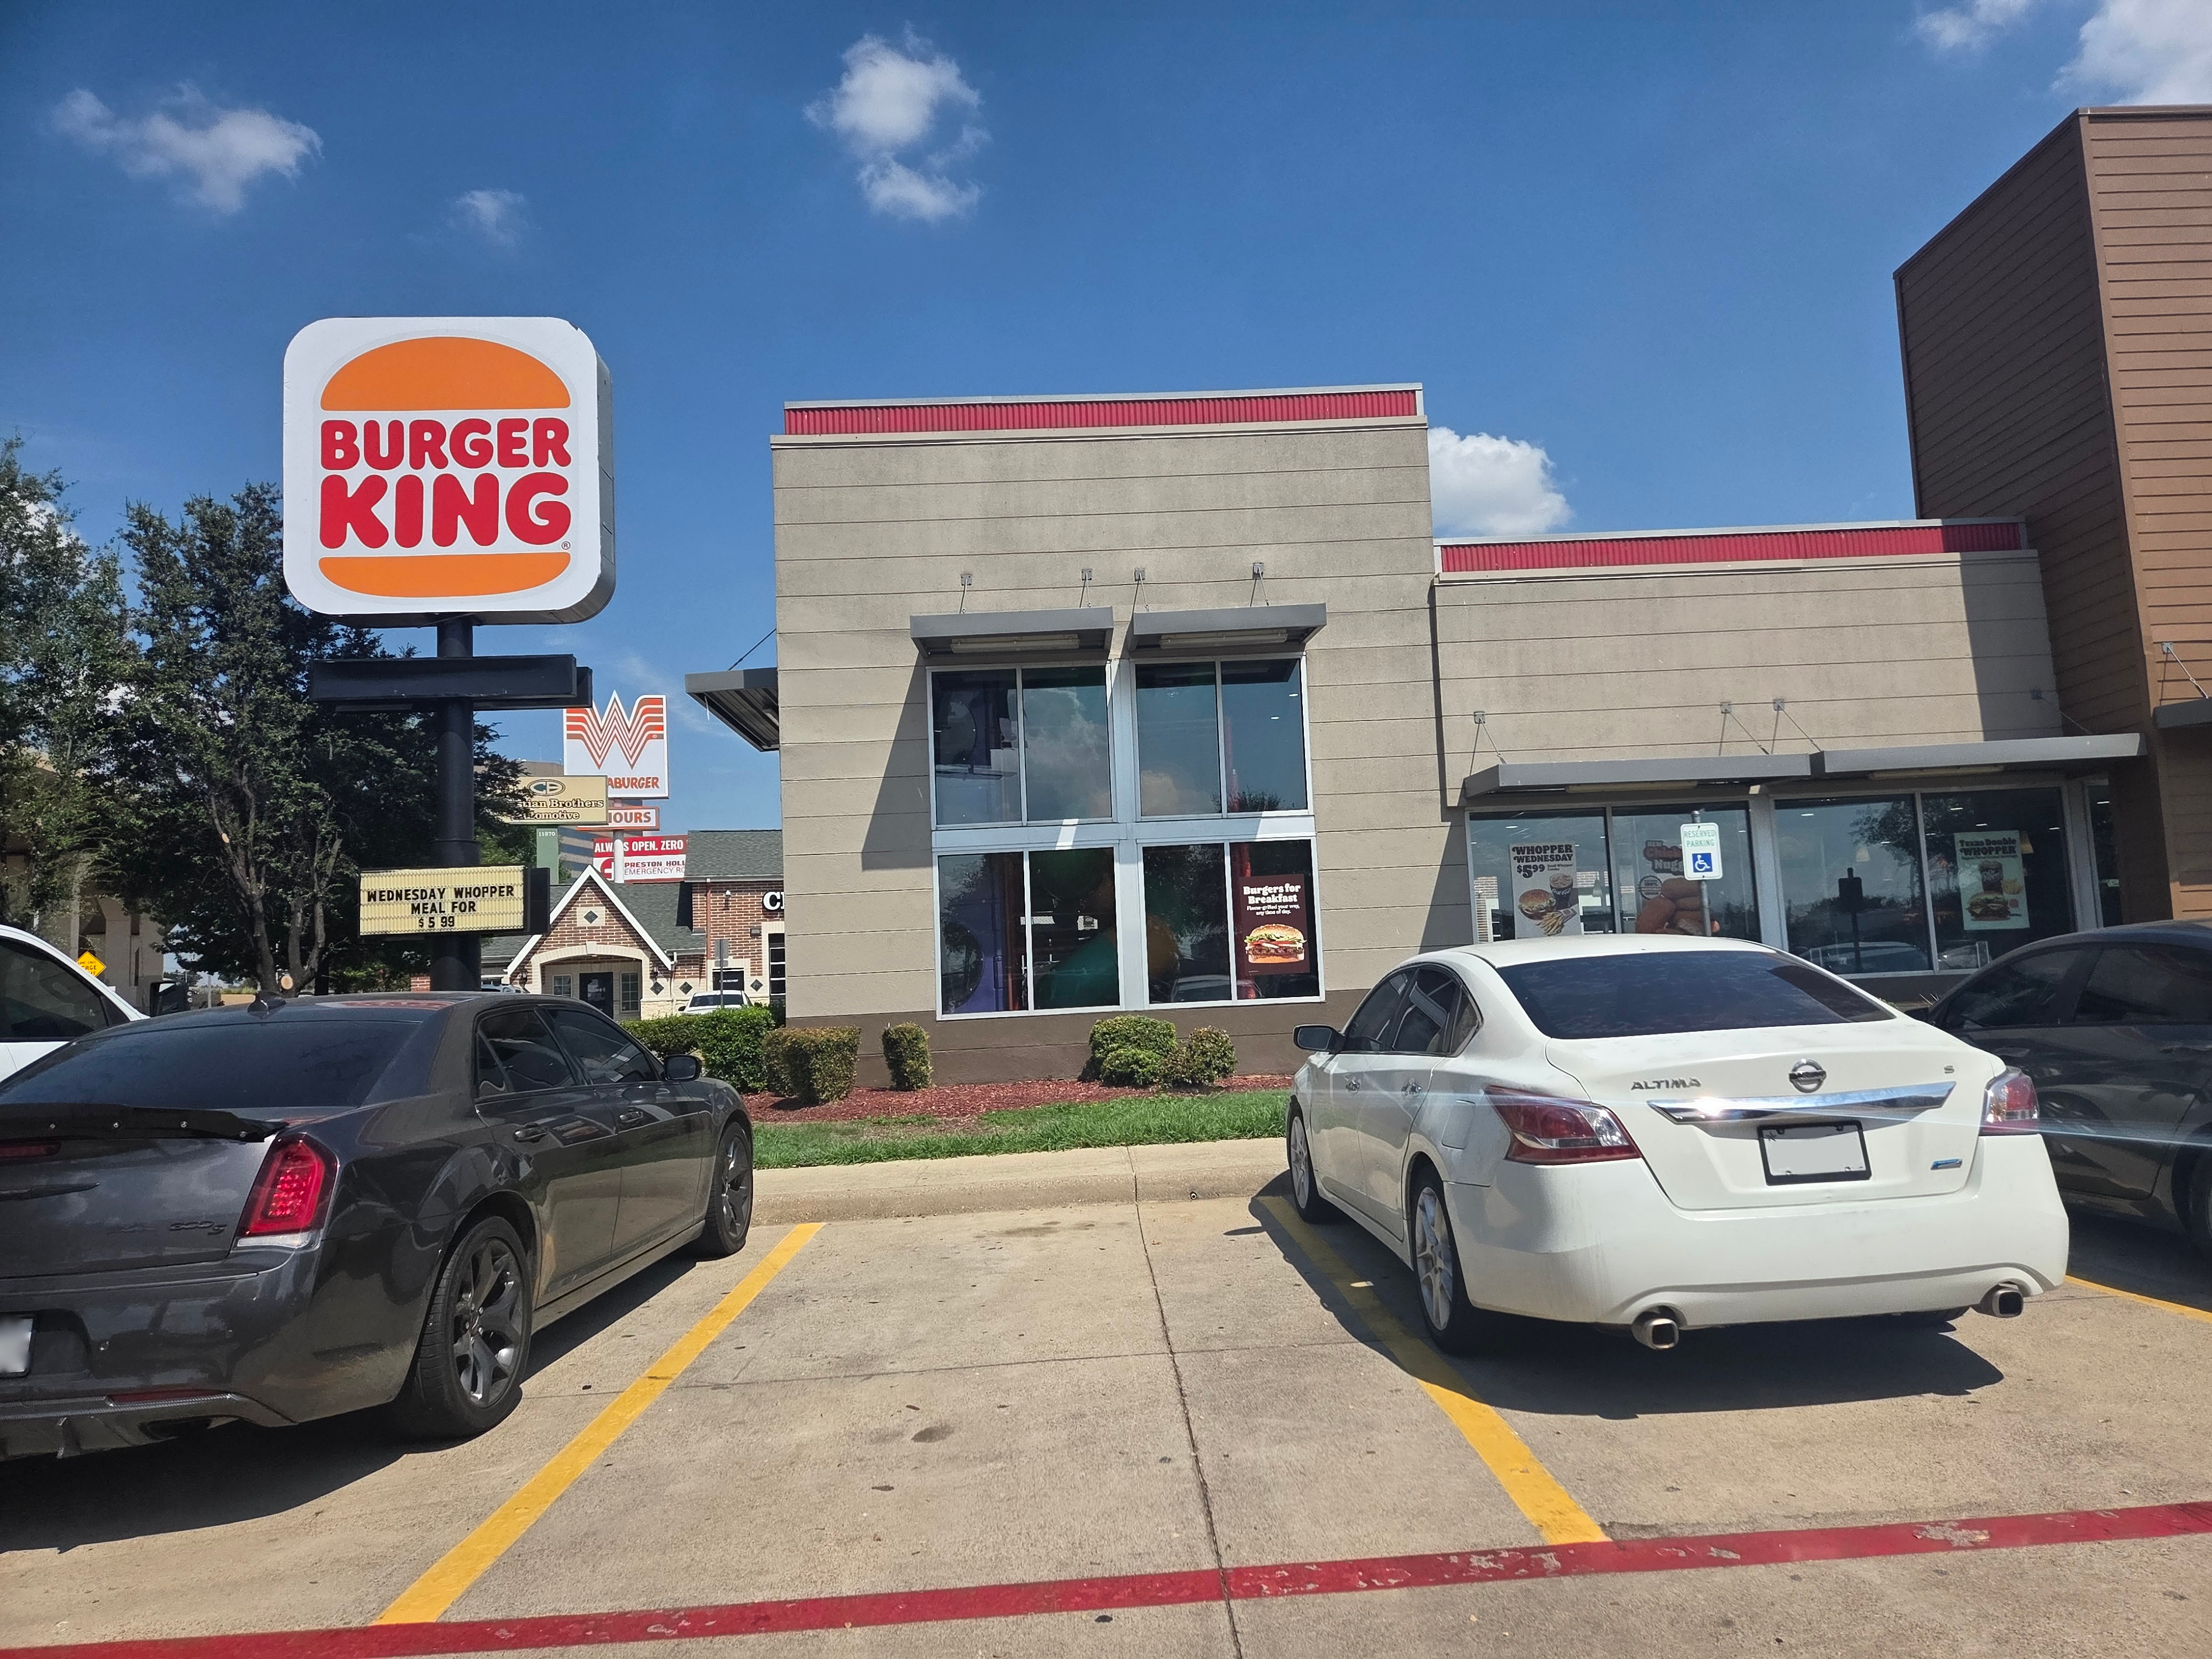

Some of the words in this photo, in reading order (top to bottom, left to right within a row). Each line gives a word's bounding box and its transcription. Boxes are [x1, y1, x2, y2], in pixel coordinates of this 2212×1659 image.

[321, 418, 571, 471] BURGER
[320, 472, 571, 549] KING
[608, 776, 660, 789] ABURGER
[517, 799, 547, 808] stian
[550, 799, 604, 808] Brothers
[523, 810, 580, 820] tomotive
[1684, 830, 1715, 838] RESERVED
[594, 842, 629, 853] ALWS
[632, 841, 658, 851] OPEN.
[661, 840, 684, 850] ZERO
[1686, 839, 1715, 847] PARKING
[1512, 844, 1573, 855] WHOPPER
[1959, 846, 2017, 856] WHOPPER
[1514, 854, 1573, 863] WEDNESDAY
[624, 867, 674, 875] EMERGENCY
[1654, 859, 1684, 872] Nugg
[367, 888, 446, 902] WEDNESDAY
[454, 885, 514, 899] WHOPPER
[1243, 885, 1284, 896] Burgers
[1285, 883, 1301, 892] for
[1248, 893, 1298, 904] Breakfast
[411, 902, 446, 915] MEAL
[451, 901, 476, 912] FOR
[1944, 1065, 1955, 1074] S
[1631, 1076, 1702, 1090] ALTIMA
